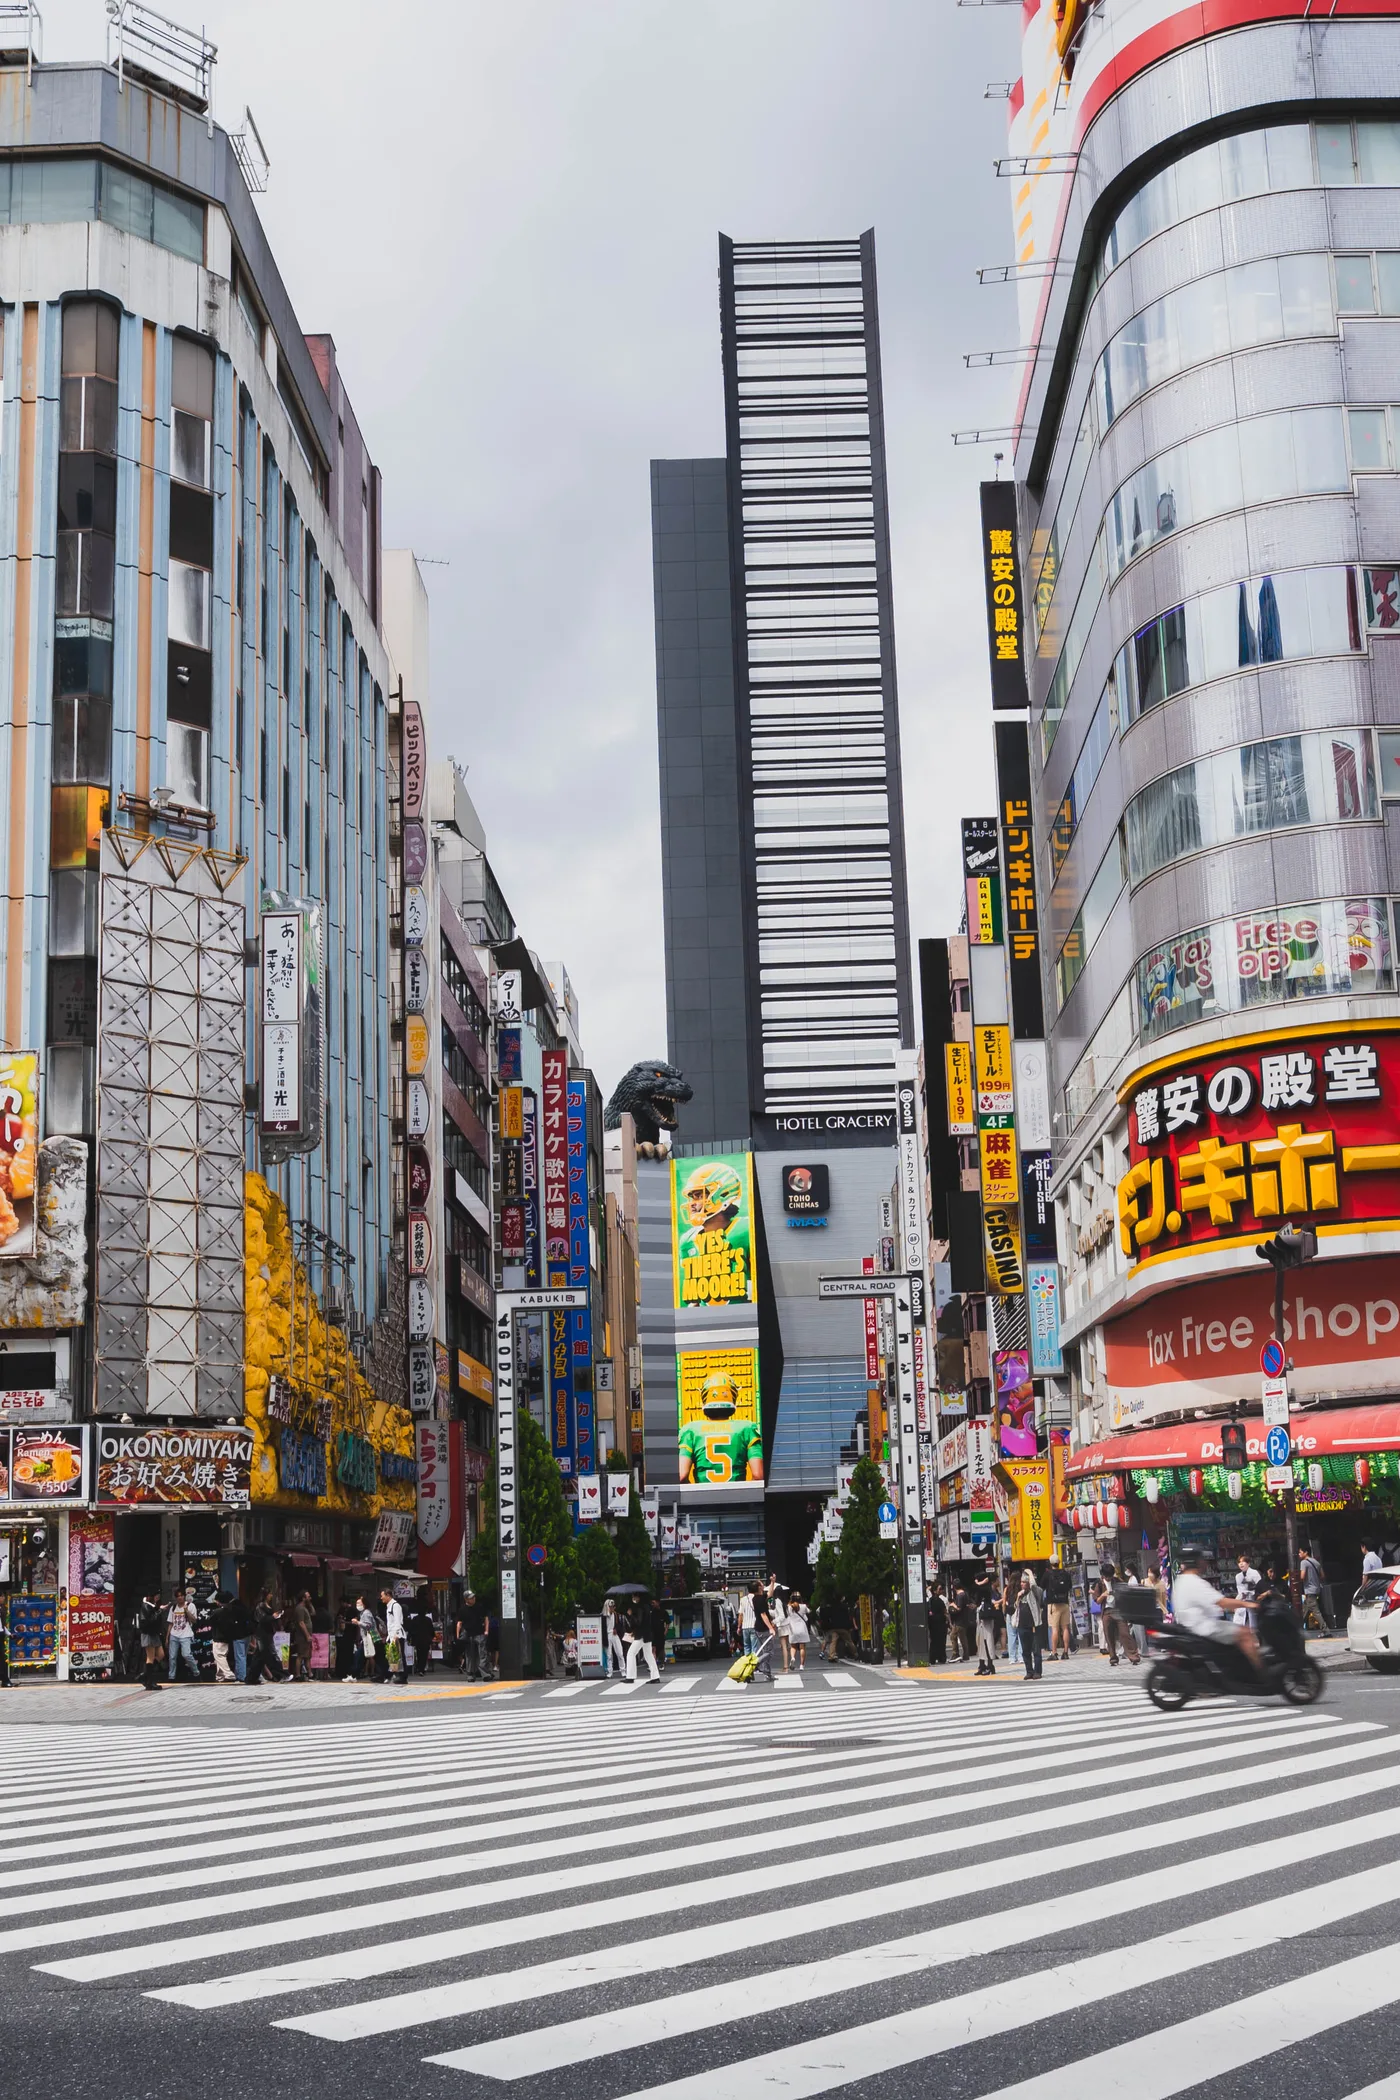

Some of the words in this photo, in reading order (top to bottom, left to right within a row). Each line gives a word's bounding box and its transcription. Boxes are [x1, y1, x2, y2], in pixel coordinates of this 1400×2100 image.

[989, 530, 1018, 660] 驚安の殿堂
[1235, 919, 1319, 950] Free
[1195, 947, 1292, 989] Sop
[408, 999, 423, 1008] 6F
[503, 979, 515, 1012] ダーツ
[952, 1047, 963, 1085] 生ビール
[983, 1030, 997, 1076] 生ビール
[274, 1090, 288, 1107] 光
[980, 1081, 1011, 1091] 199円
[1135, 1045, 1381, 1144] 驚安の殿堂
[776, 1117, 823, 1131] HOTEL
[826, 1115, 893, 1129] GRACERY
[900, 1089, 914, 1127] Booth
[986, 1115, 1007, 1128] 4F
[275, 1121, 288, 1132] 4F
[544, 1058, 567, 1229] カラオケ歌広場
[986, 1133, 1012, 1180] 麻雀
[508, 1150, 517, 1186] 山内農場
[905, 1139, 914, 1183] ネットカフェ
[985, 1184, 1008, 1192] スリー
[786, 1218, 828, 1228] IMAX
[908, 1197, 917, 1227] カプセル
[414, 1223, 425, 1268] お好み焼き
[695, 1228, 730, 1255] YES,
[985, 1209, 1022, 1288] CASINO
[682, 1247, 745, 1280] THERE'S
[682, 1271, 746, 1301] MOORE!
[823, 1282, 867, 1292] CENTRAL
[869, 1280, 896, 1290] ROAD
[910, 1277, 923, 1317] Booth
[1045, 1302, 1055, 1330] IDOL
[1147, 1328, 1176, 1368] Tax
[1182, 1316, 1254, 1358] Free
[1269, 1297, 1400, 1345] Shop
[412, 1359, 427, 1395] かっぱ
[498, 1330, 513, 1453] GODZILLA
[414, 1398, 426, 1406] B1
[898, 1333, 917, 1496] ゴジラロード
[1121, 1405, 1130, 1416] Don
[15, 1430, 67, 1445] らーめん
[17, 1448, 50, 1457] Ramen
[101, 1437, 254, 1461] OKONOMIYAKI
[438, 1423, 448, 1464] 大衆酒場
[1201, 1442, 1223, 1458] Do
[420, 1428, 436, 1499] トラノコ
[705, 1435, 733, 1483] 5
[973, 1454, 985, 1476] 九十九
[1012, 1466, 1046, 1476] カラオケ
[109, 1463, 240, 1489] お好み焼き
[499, 1466, 514, 1525] ROAD
[71, 1611, 112, 1625] 3,380円
